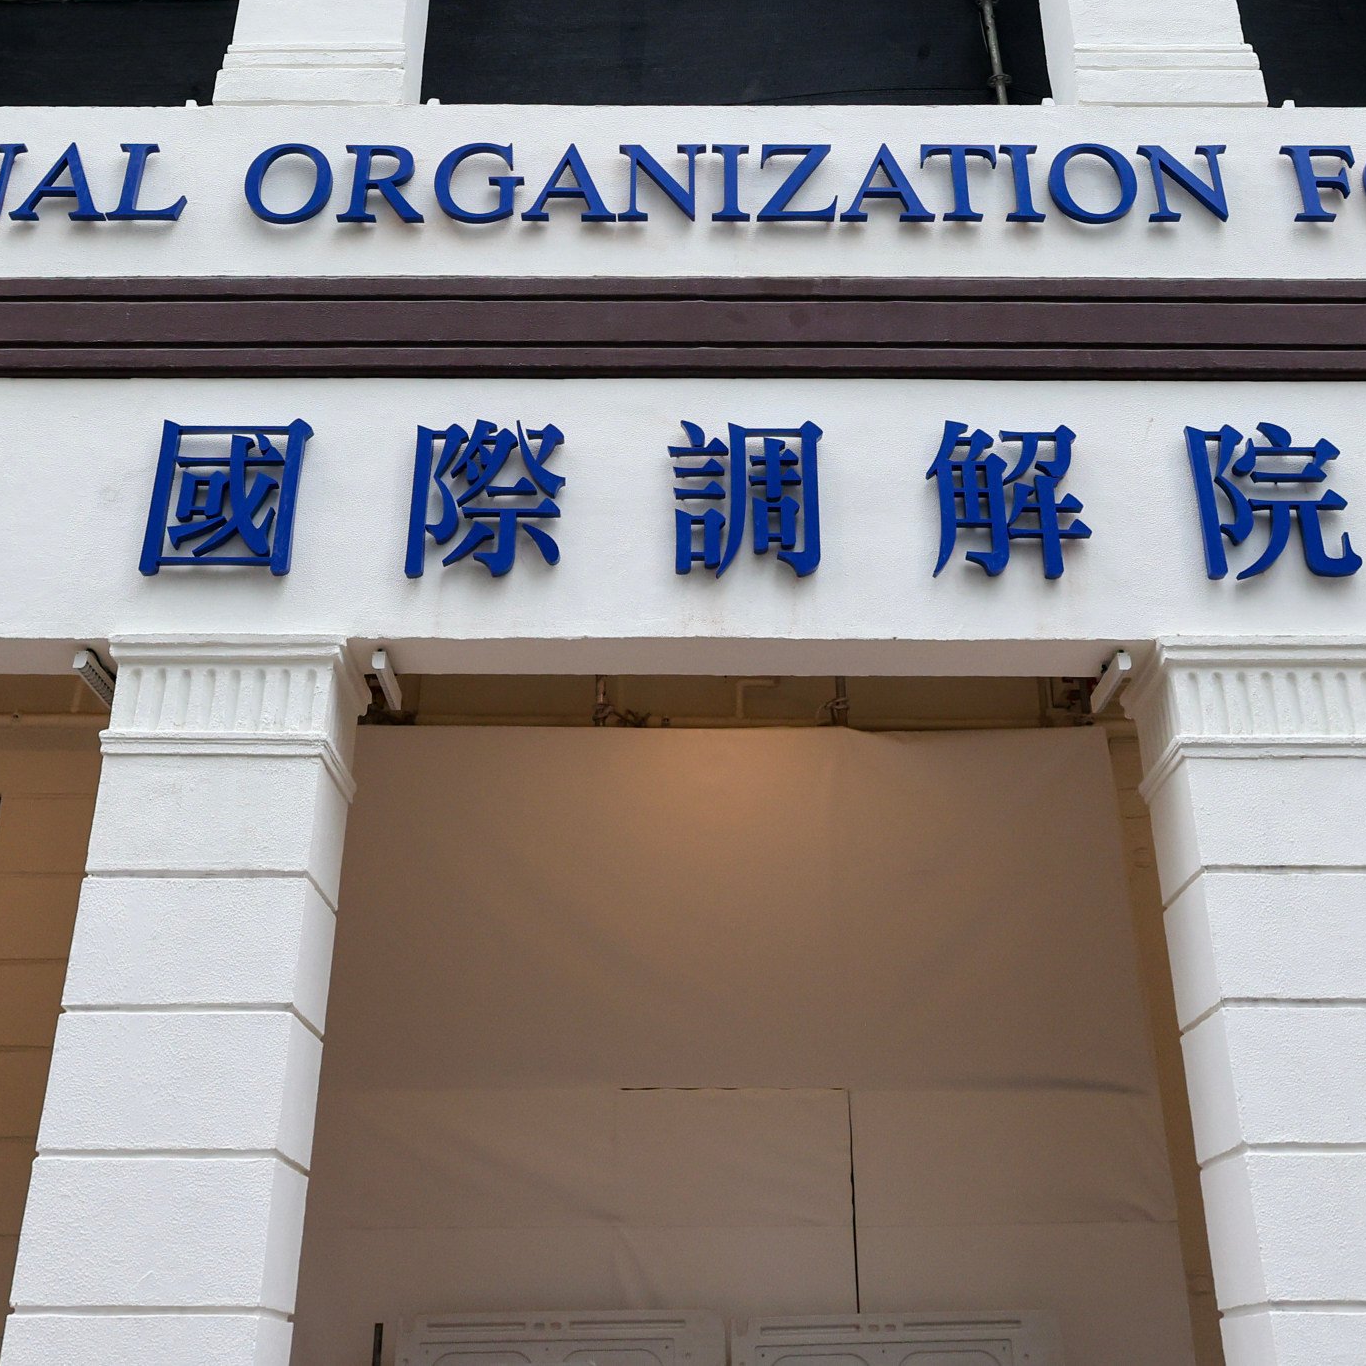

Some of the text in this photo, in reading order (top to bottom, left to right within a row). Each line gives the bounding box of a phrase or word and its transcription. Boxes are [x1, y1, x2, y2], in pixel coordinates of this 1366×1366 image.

[244, 142, 1229, 225] ORGANIZATION
[138, 418, 1363, 580] 國際調解院
